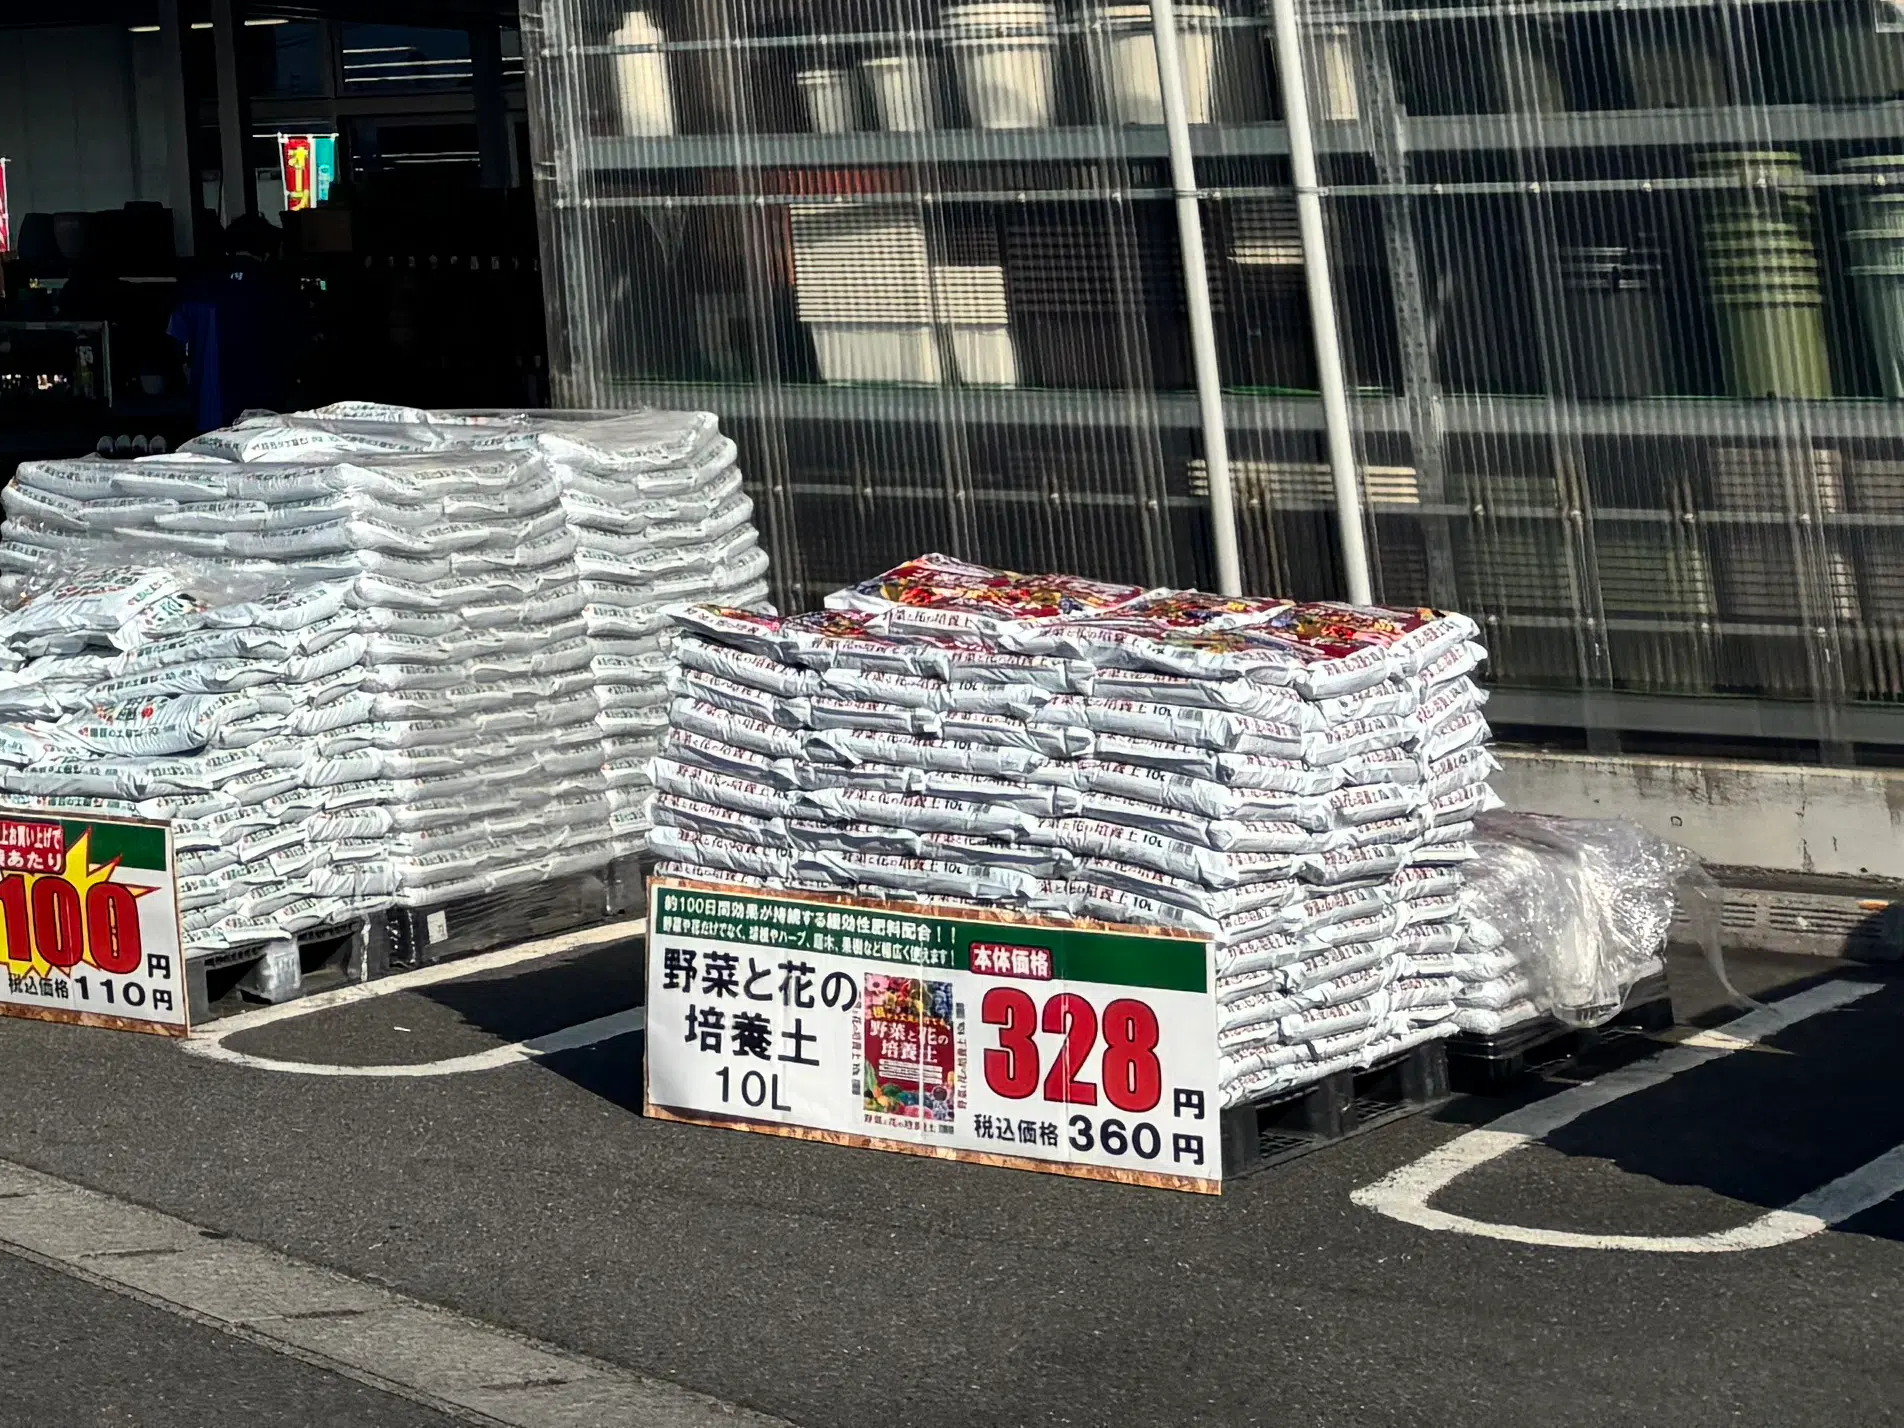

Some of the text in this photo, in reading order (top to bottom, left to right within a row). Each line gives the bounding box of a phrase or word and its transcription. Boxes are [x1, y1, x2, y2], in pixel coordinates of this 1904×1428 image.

[663, 948, 857, 1013] 野菜と花の
[972, 946, 1051, 978] 本体価格
[8, 972, 70, 1000] 税込価格
[685, 1004, 820, 1067] 培養土
[982, 986, 1162, 1113] 328
[716, 1068, 791, 1113] 10L
[973, 1114, 1059, 1148] 税込価格
